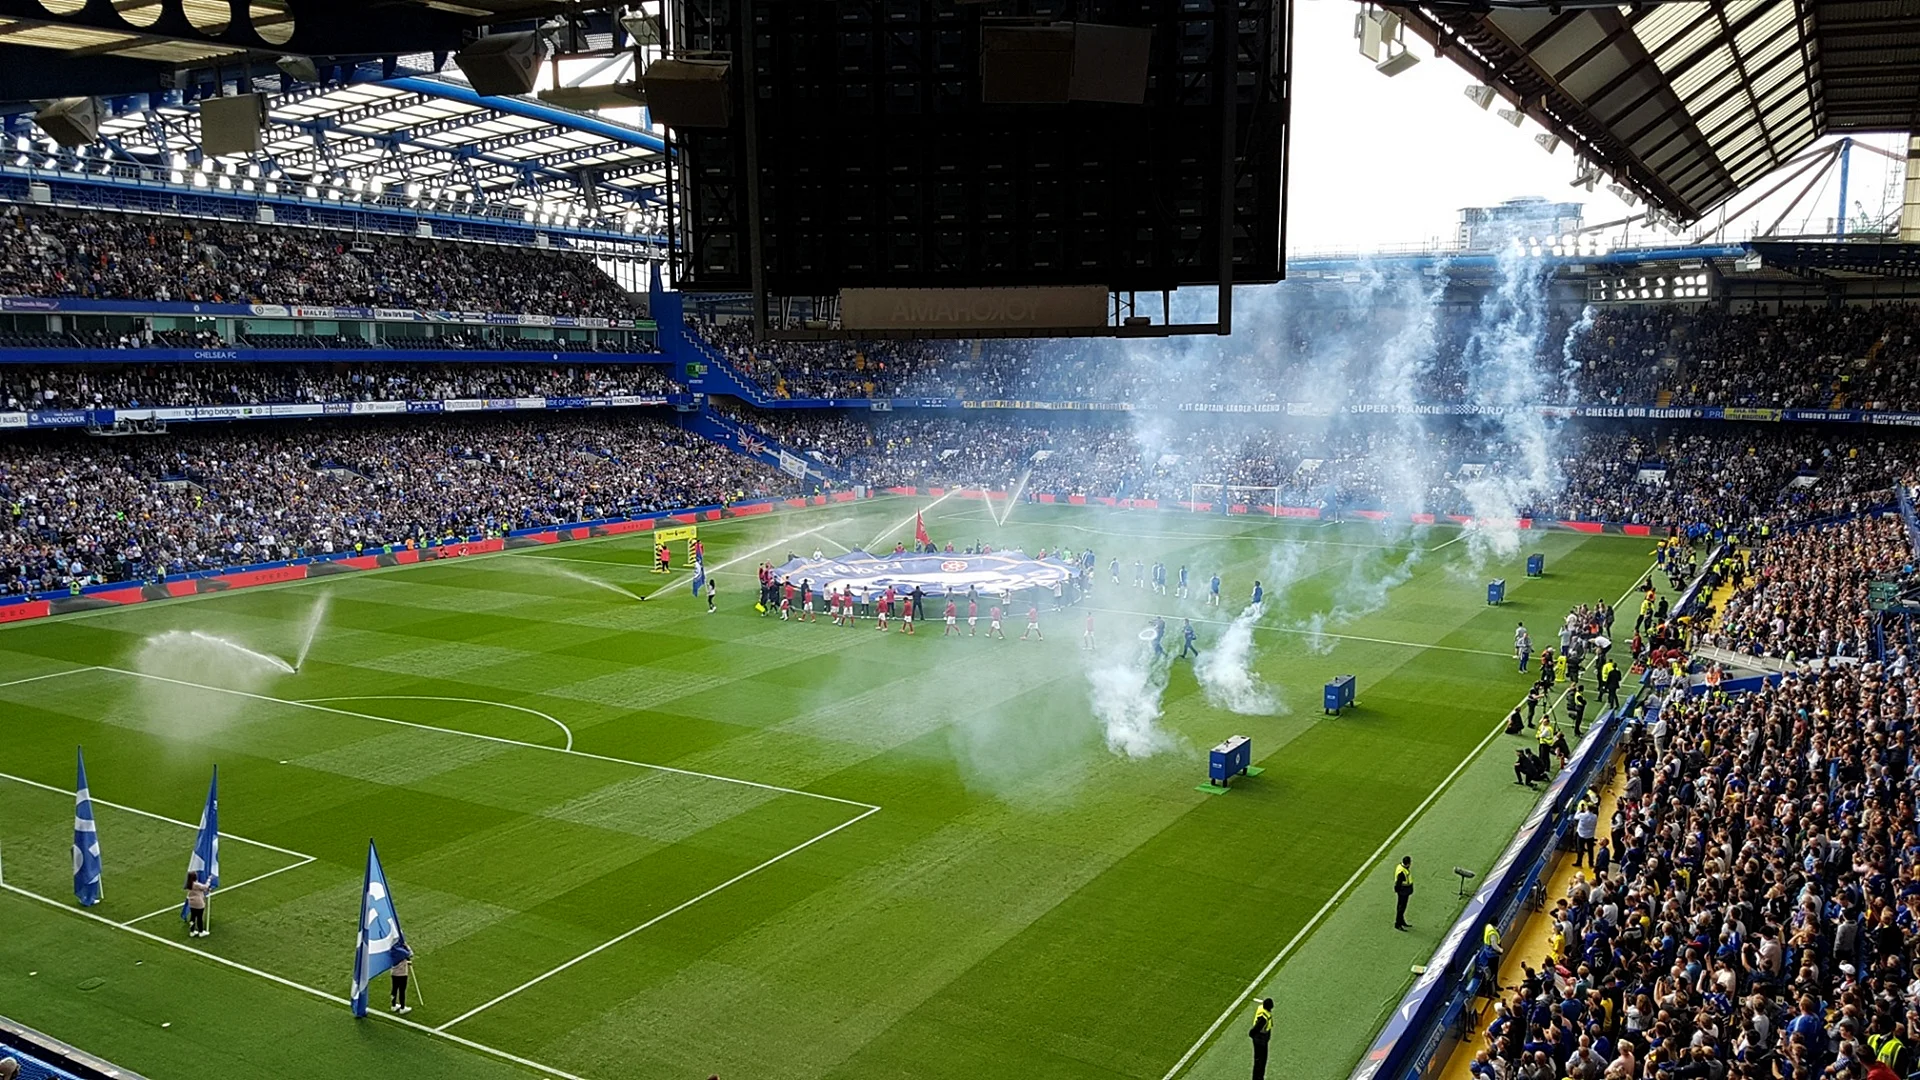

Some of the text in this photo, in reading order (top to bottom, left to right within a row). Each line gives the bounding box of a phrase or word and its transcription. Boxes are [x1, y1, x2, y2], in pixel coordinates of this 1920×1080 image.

[303, 309, 327, 317] MALTA
[214, 408, 240, 417] bridges
[1351, 405, 1389, 414] SUPER
[1470, 405, 1504, 415] PARD
[1585, 407, 1624, 417] CHELSEA
[1627, 408, 1646, 417] OUR
[1649, 408, 1692, 419] RELIGION
[1709, 410, 1724, 419] PRI
[42, 416, 85, 424] VANCOUVER
[1797, 412, 1826, 420] LONDON'S
[254, 571, 289, 582] SPEED
